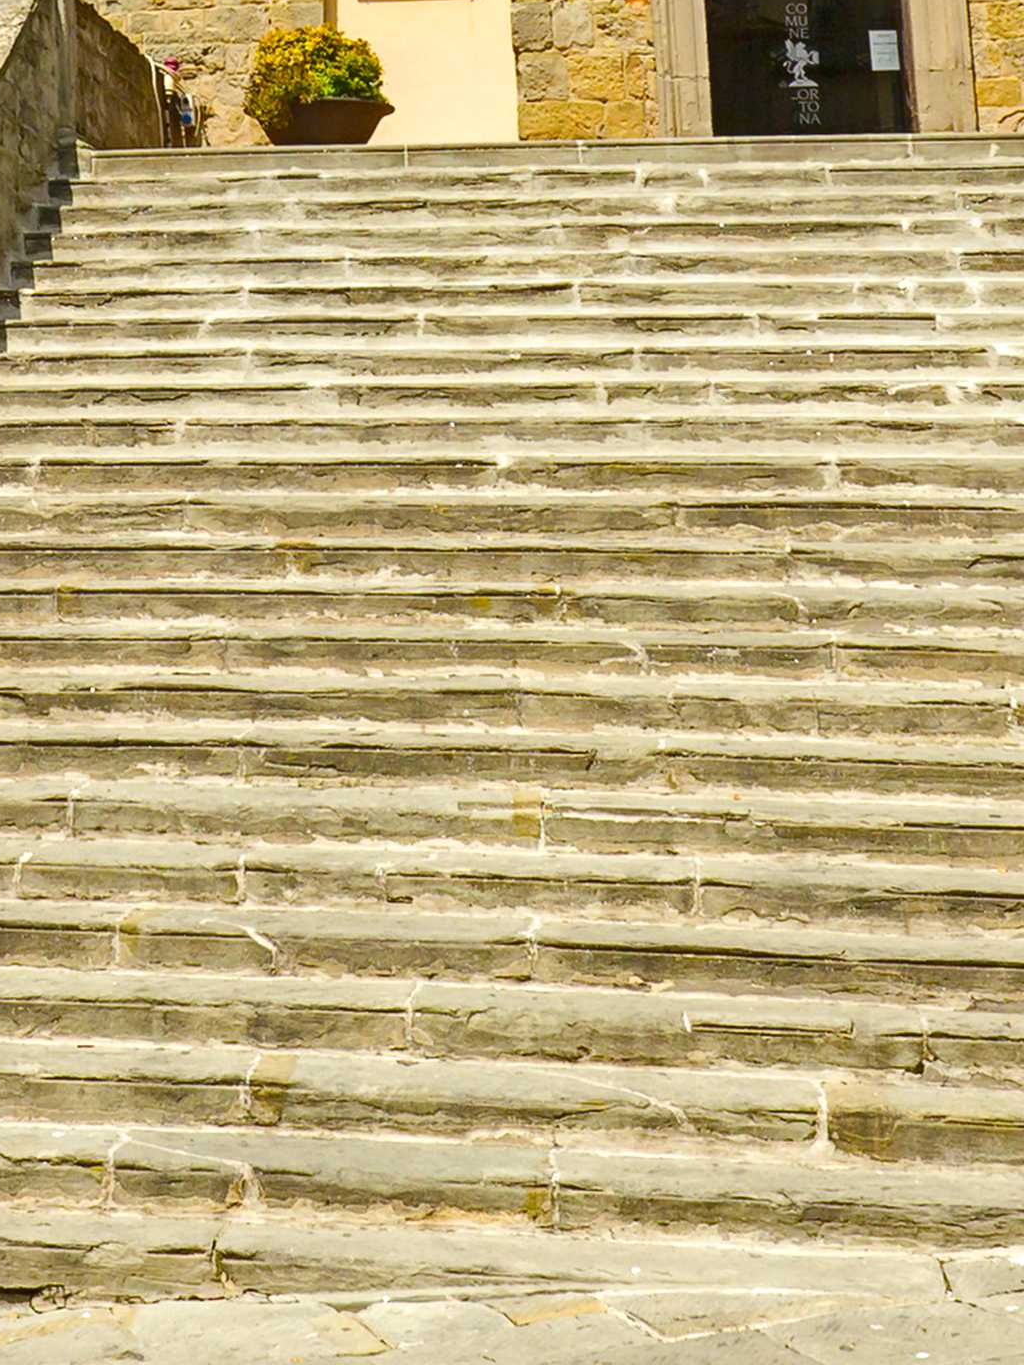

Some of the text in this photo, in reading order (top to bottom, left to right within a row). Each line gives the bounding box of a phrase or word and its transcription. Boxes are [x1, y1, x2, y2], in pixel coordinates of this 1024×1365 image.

[785, 3, 808, 16] CO
[784, 15, 808, 28] MU
[788, 27, 810, 39] NE
[798, 100, 820, 113] TO
[799, 113, 822, 126] NA
